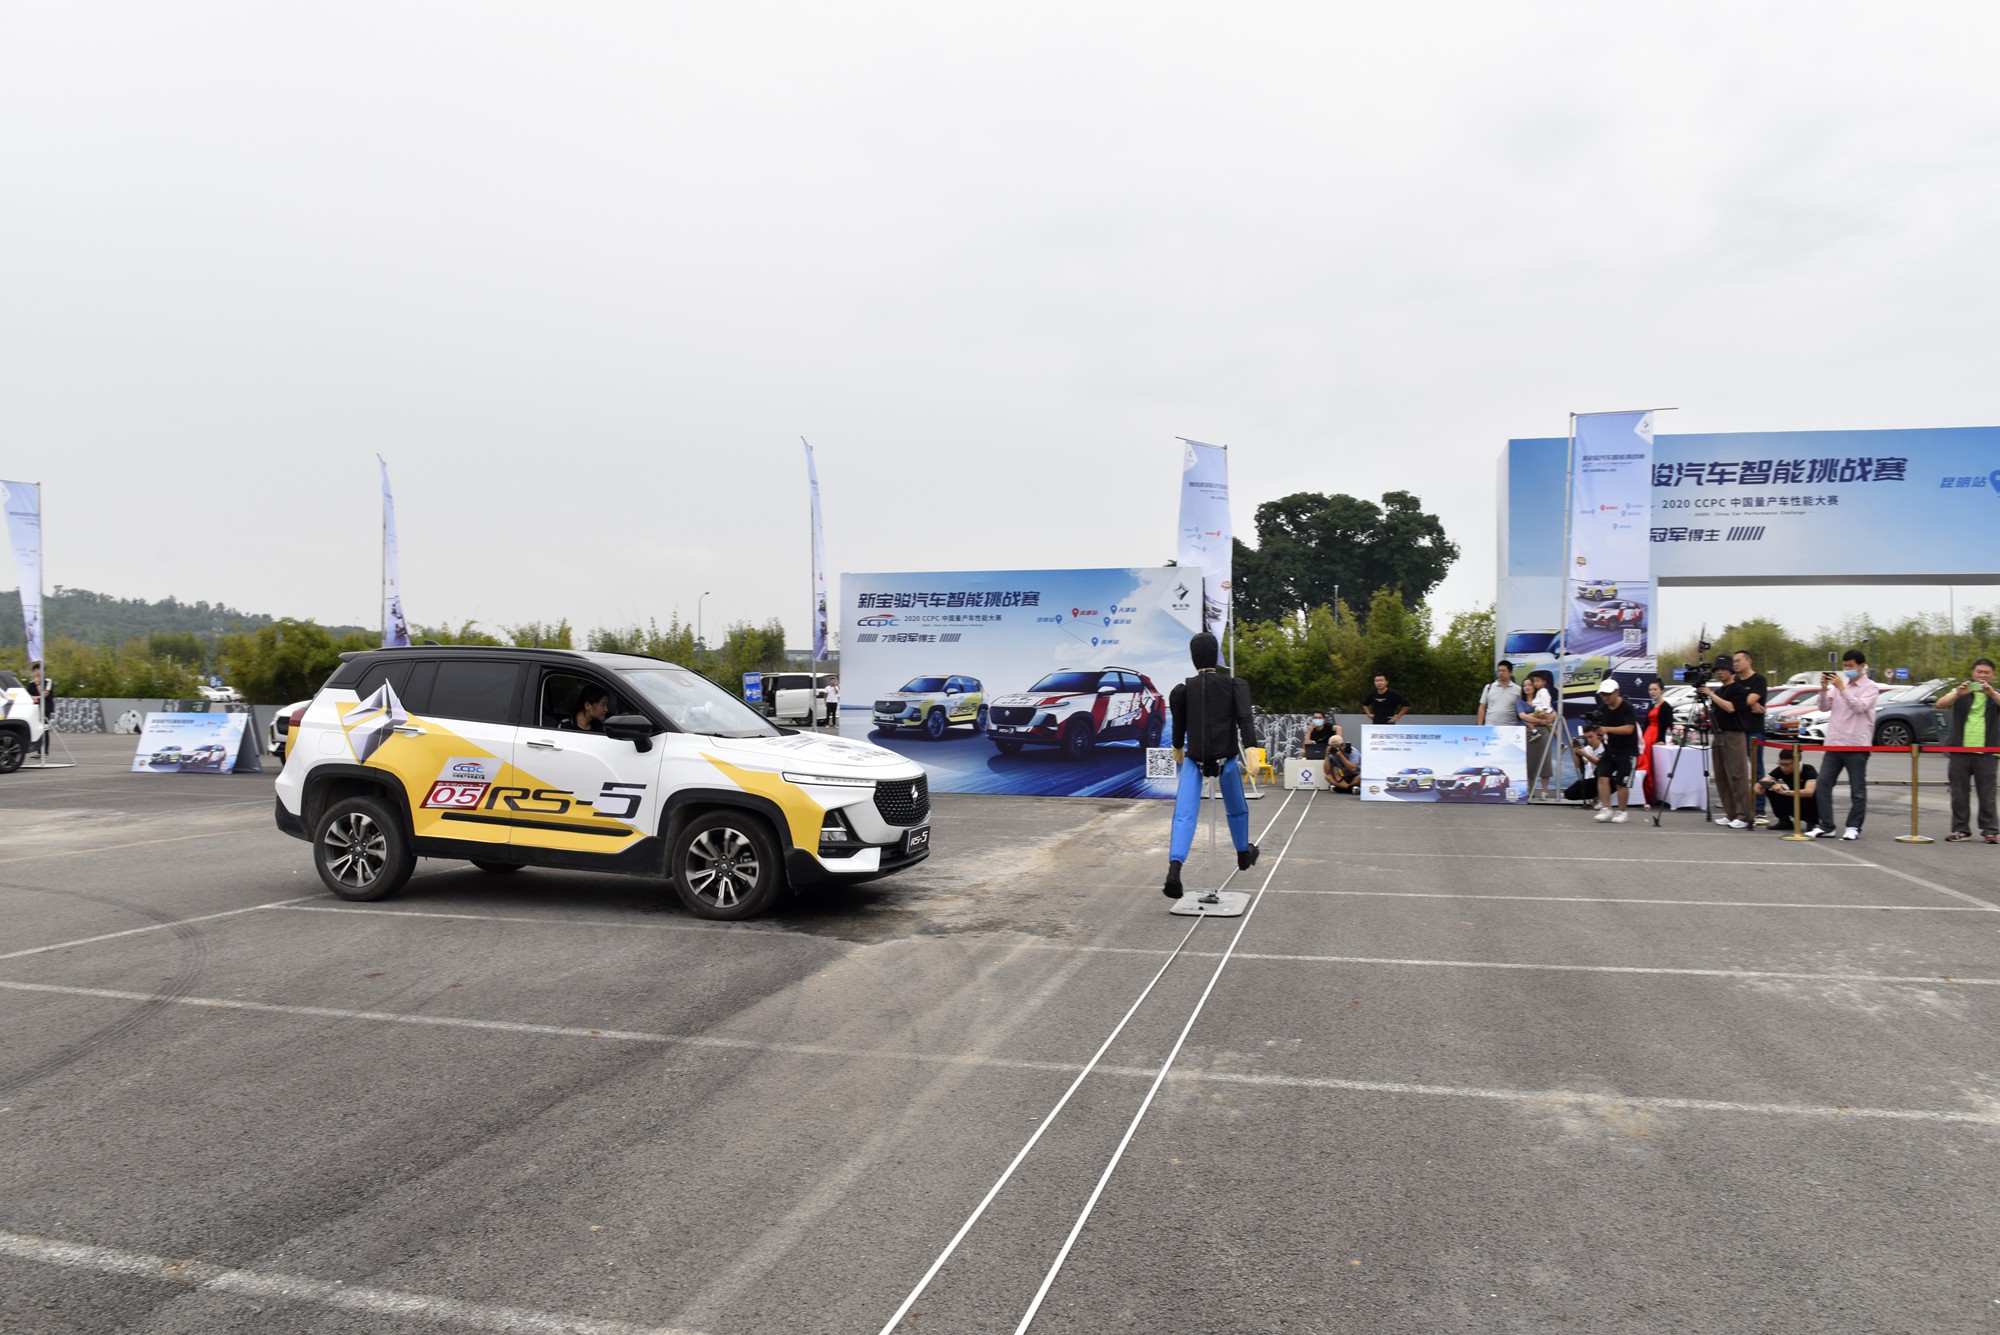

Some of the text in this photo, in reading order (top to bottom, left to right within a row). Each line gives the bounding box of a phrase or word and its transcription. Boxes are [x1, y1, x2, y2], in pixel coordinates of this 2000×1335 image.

[1940, 476, 1987, 488] 昆明站
[1662, 495, 1839, 509] 2020 CCPC 中国量产车性能大赛
[858, 591, 1040, 608] 新宝骏汽车智能挑战赛
[942, 614, 1002, 622] 中国量产车性能大赛
[881, 633, 937, 643] 7项冠军得主
[432, 787, 480, 805] 05
[484, 782, 647, 819] RS-5
[910, 830, 929, 847] RS-5
